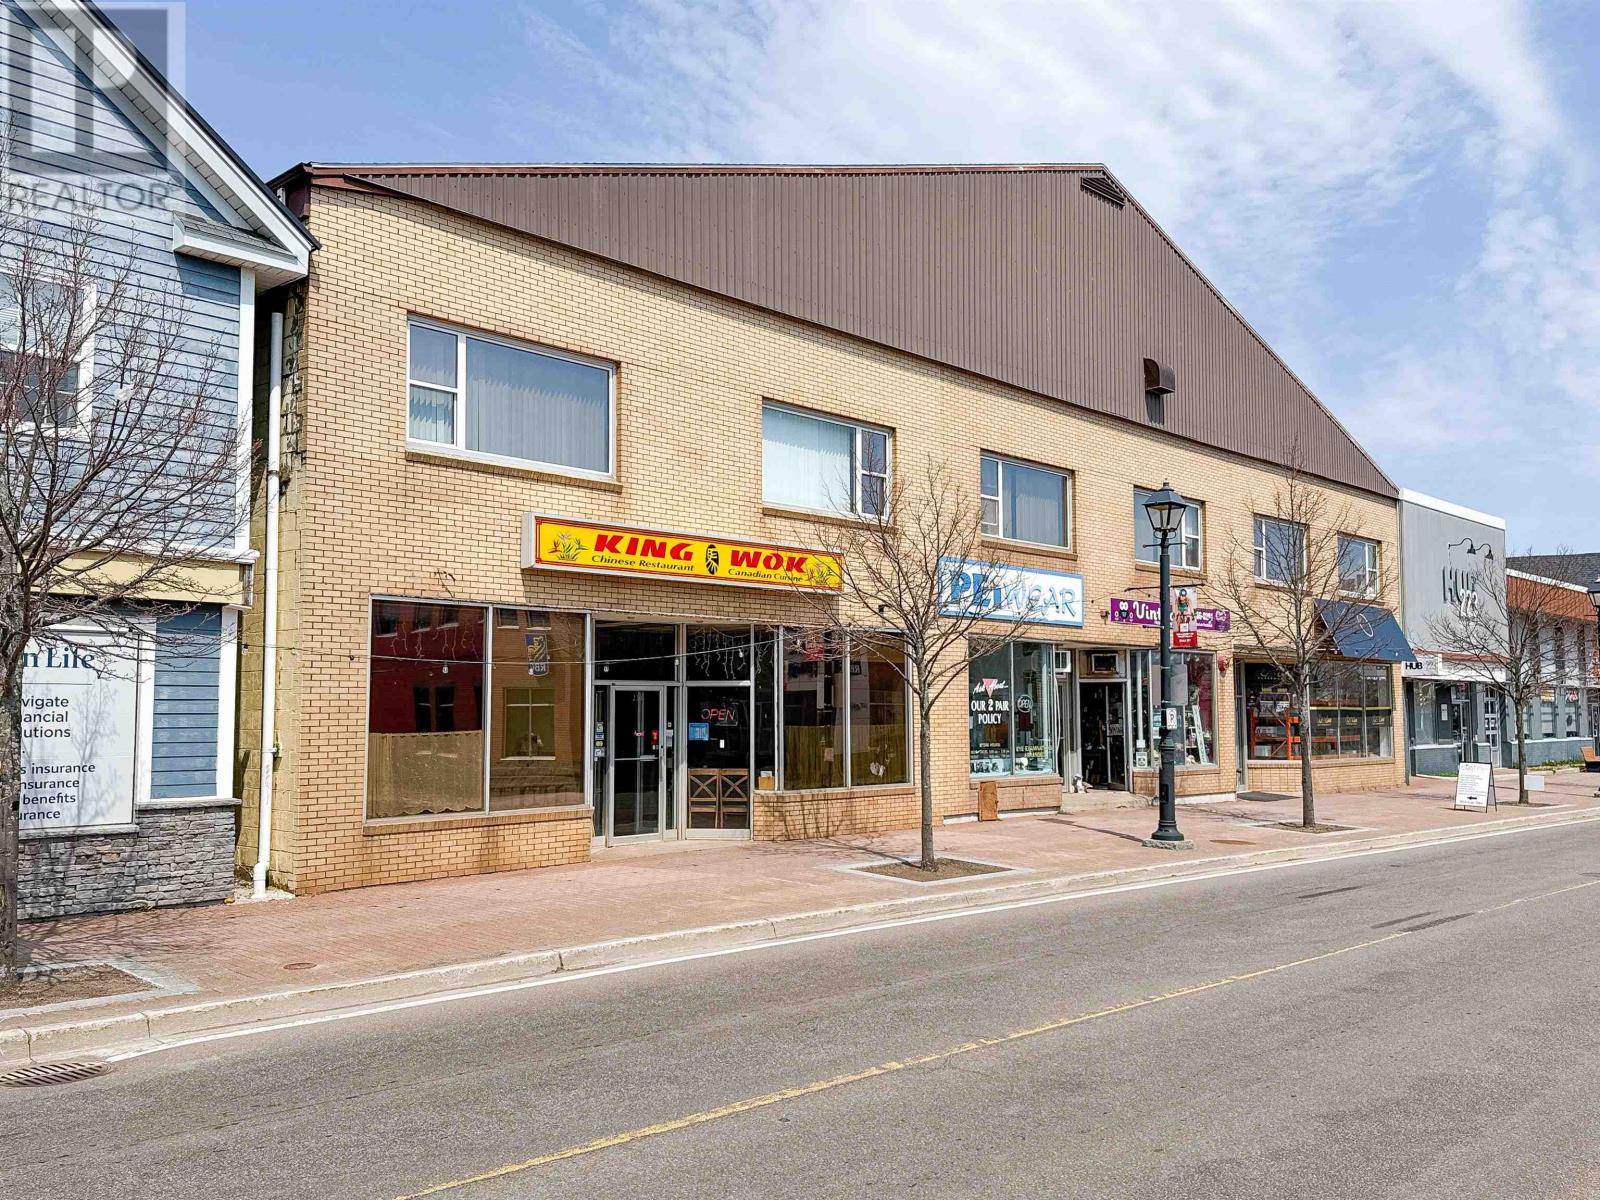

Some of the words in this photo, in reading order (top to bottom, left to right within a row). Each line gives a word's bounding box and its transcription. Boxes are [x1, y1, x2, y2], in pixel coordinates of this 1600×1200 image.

[594, 534, 694, 561] KING
[730, 549, 809, 573] WOK
[591, 554, 636, 566] Chinese
[638, 559, 694, 571] Restaurant
[728, 568, 773, 580] Canadian
[1405, 661, 1423, 670] HUB
[21, 696, 70, 710] vigate
[970, 700, 986, 711] OUR
[988, 699, 994, 711] 2
[995, 700, 1010, 712] PAIR
[23, 711, 69, 723] ancial
[700, 708, 736, 721] OPEN
[978, 713, 1002, 725] POLICY
[23, 726, 71, 738] utions
[31, 763, 96, 775] insurance
[20, 779, 80, 790] nsurance
[22, 792, 77, 805] benefits
